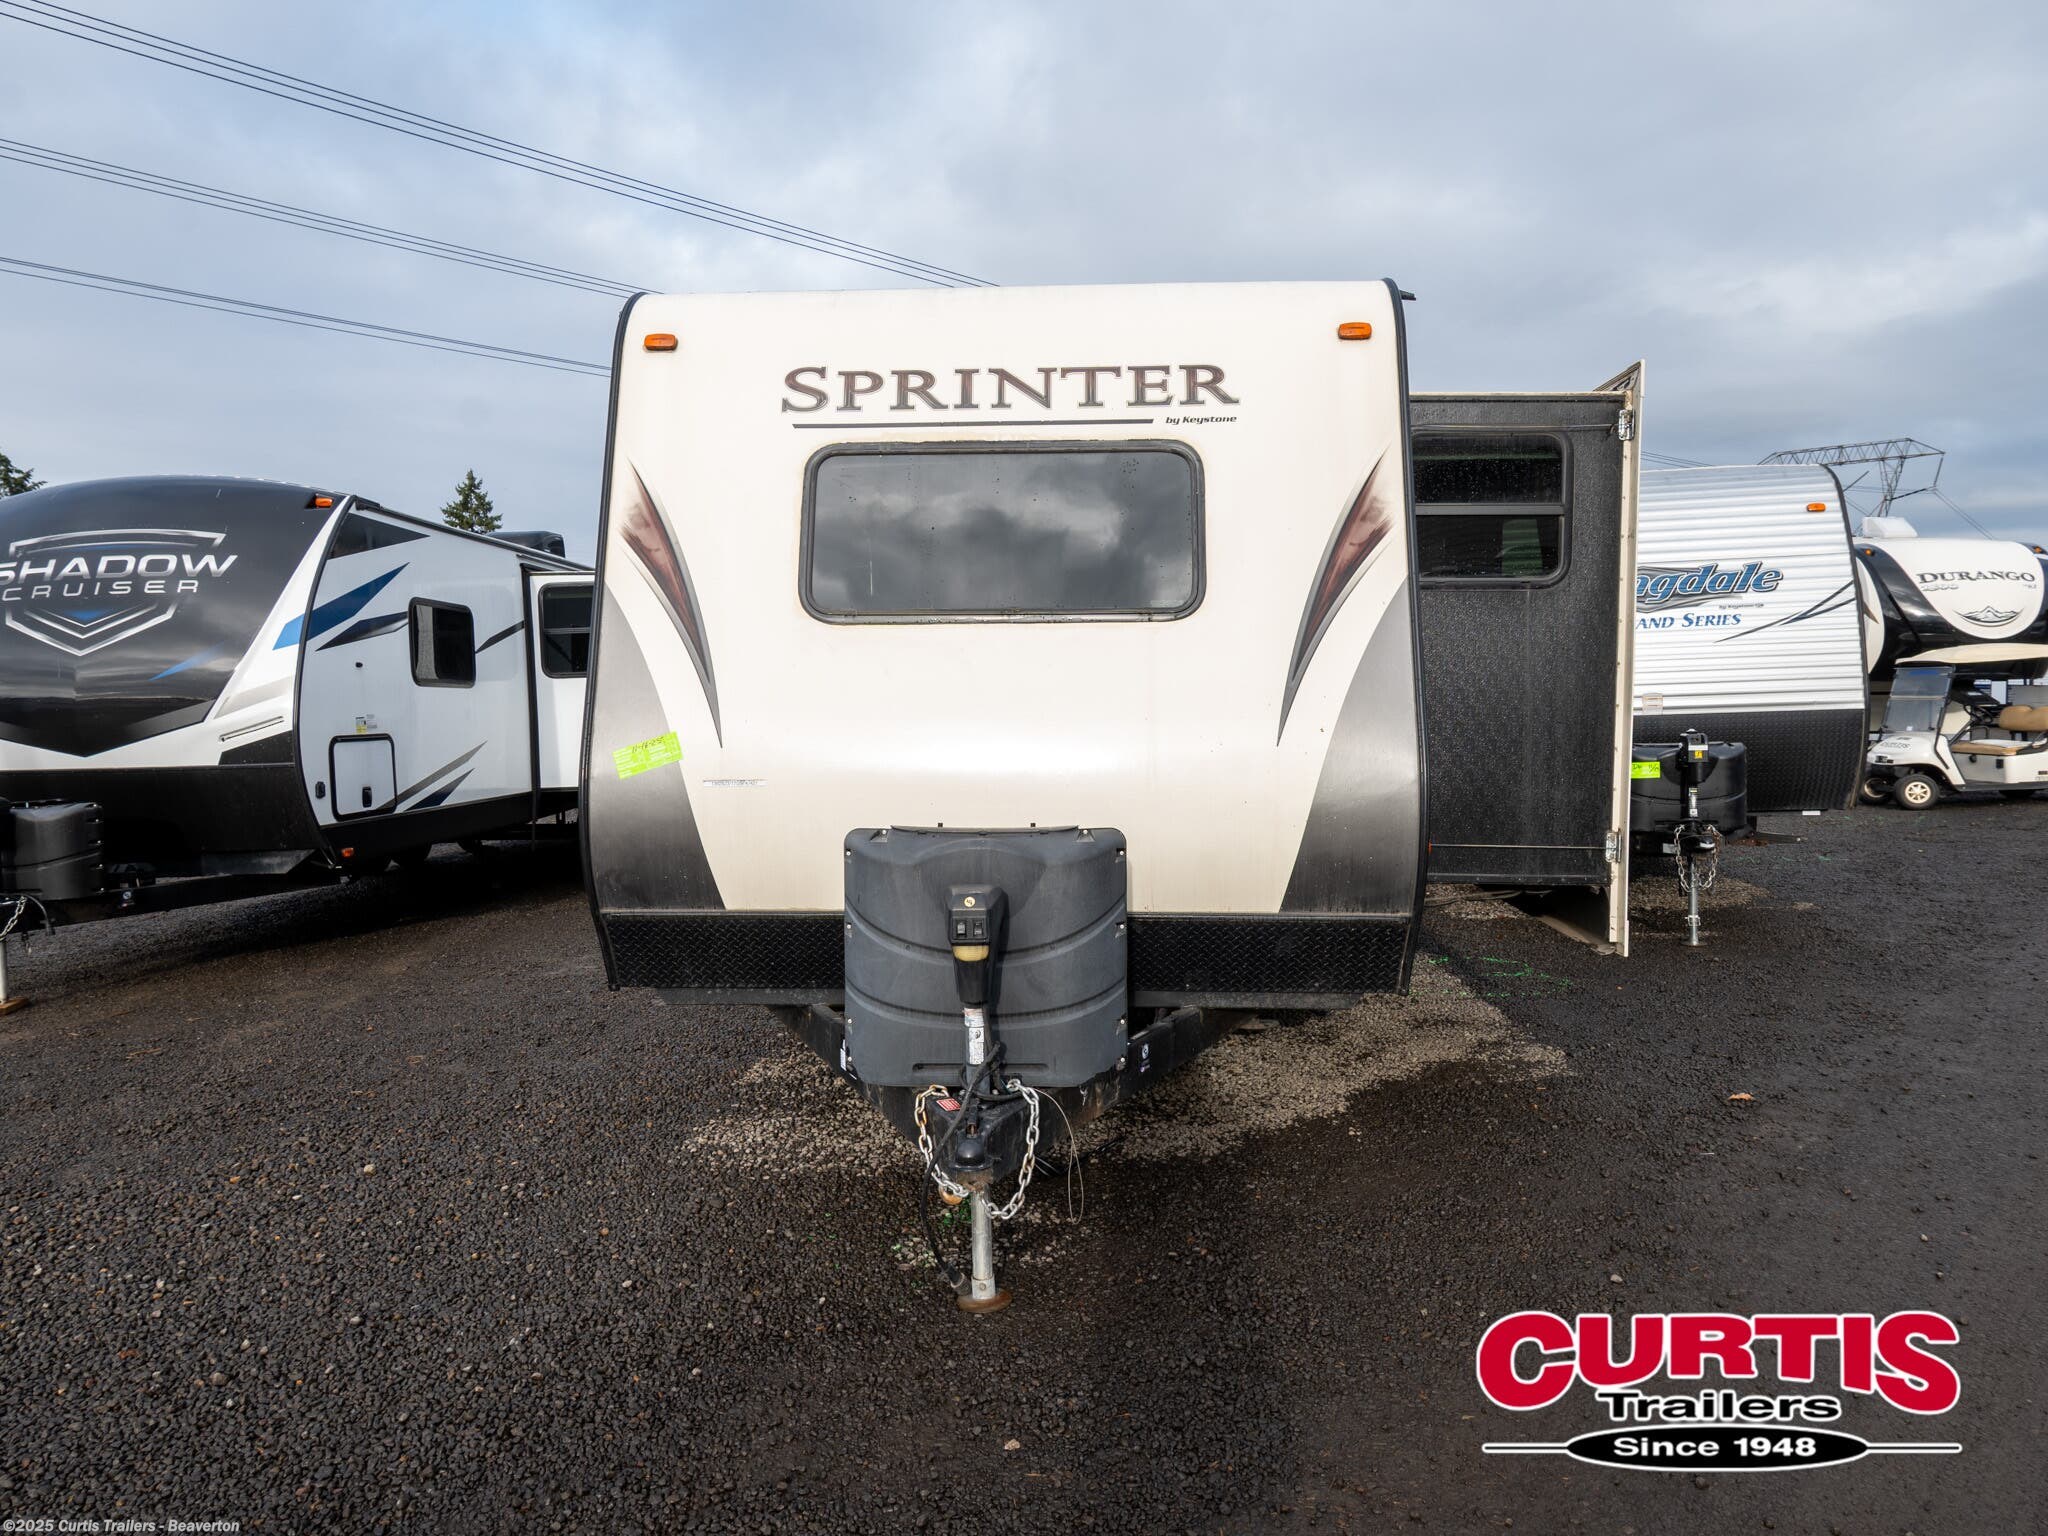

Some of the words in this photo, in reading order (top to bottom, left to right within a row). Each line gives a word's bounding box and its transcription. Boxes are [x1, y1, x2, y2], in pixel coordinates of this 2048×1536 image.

[781, 364, 1240, 413] SPRINTER
[1165, 416, 1180, 425] by
[1182, 416, 1237, 425] Keystone
[0, 554, 238, 586] SHADOW
[1916, 571, 2035, 583] DURANGO
[2, 580, 199, 600] CRUISER
[1682, 613, 1742, 627] SERIES
